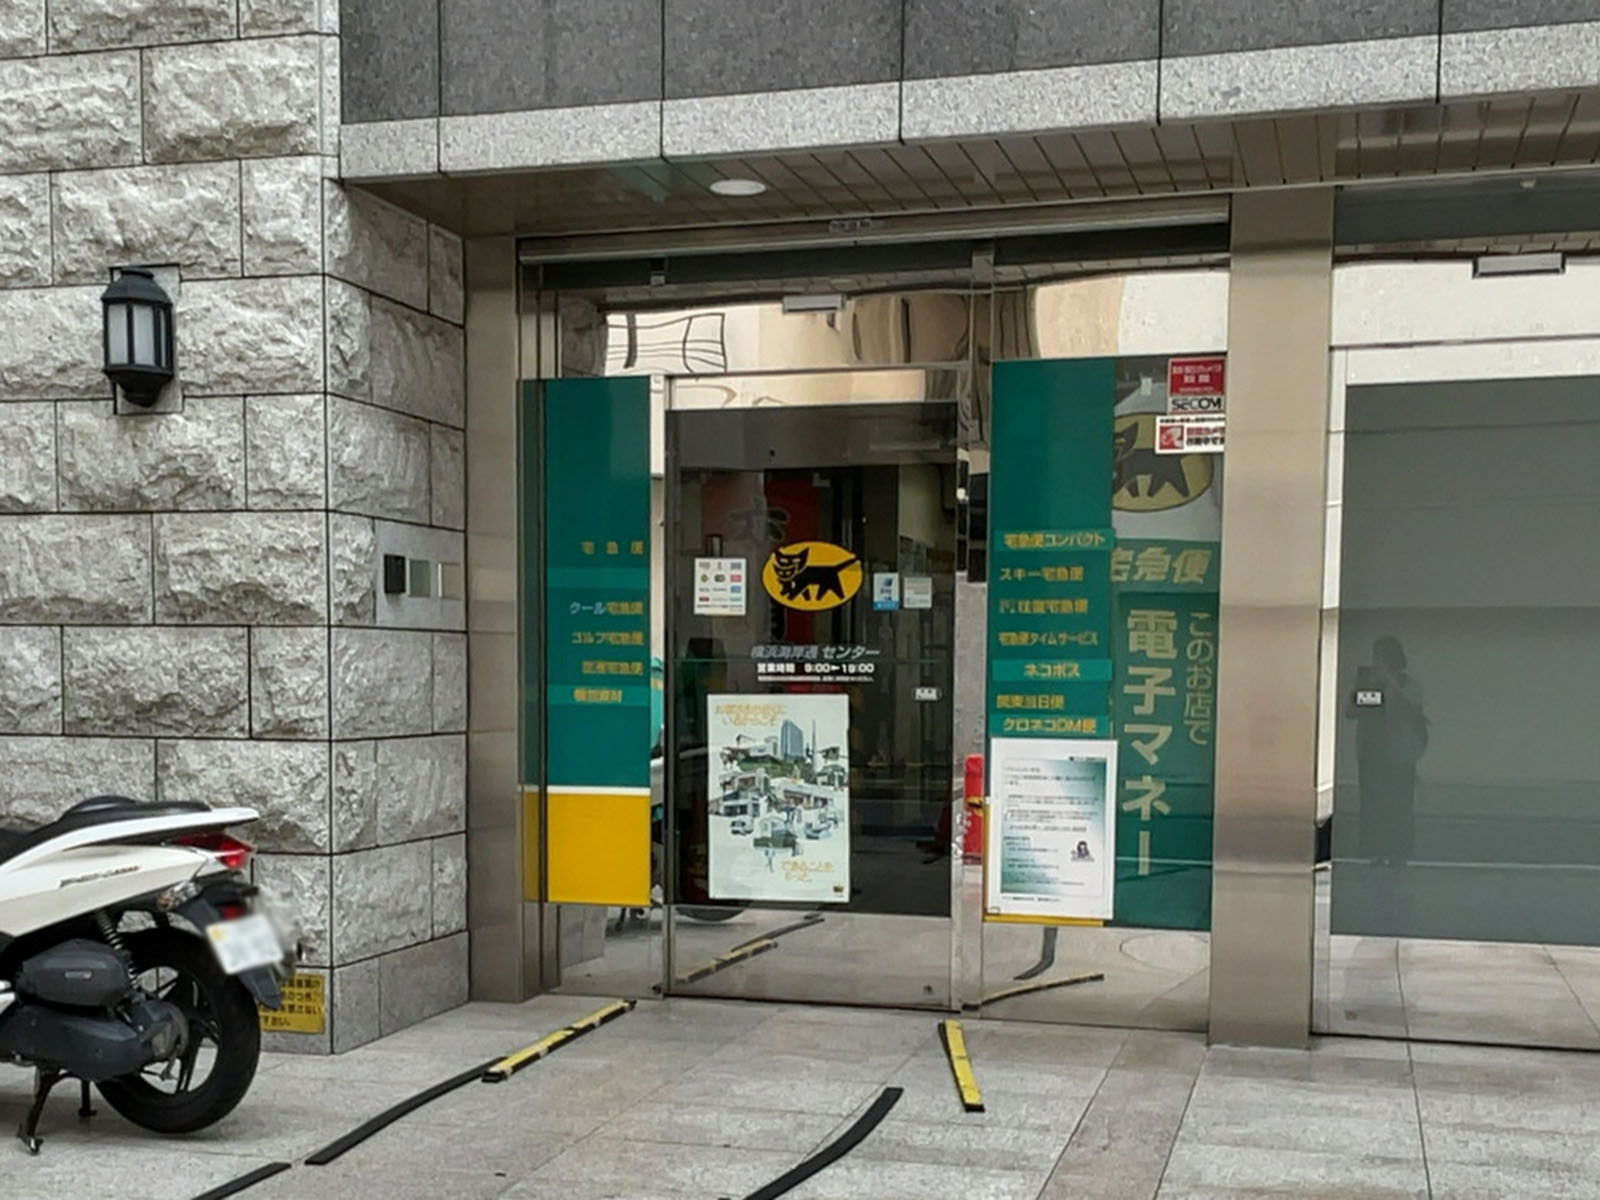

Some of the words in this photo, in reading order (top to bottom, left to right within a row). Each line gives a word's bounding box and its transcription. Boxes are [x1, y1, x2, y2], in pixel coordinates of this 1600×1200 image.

[822, 645, 880, 659] センター
[1024, 663, 1080, 678] ネコポス
[1003, 717, 1097, 734] クロネコDM便
[1122, 609, 1178, 877] 電子マネー
